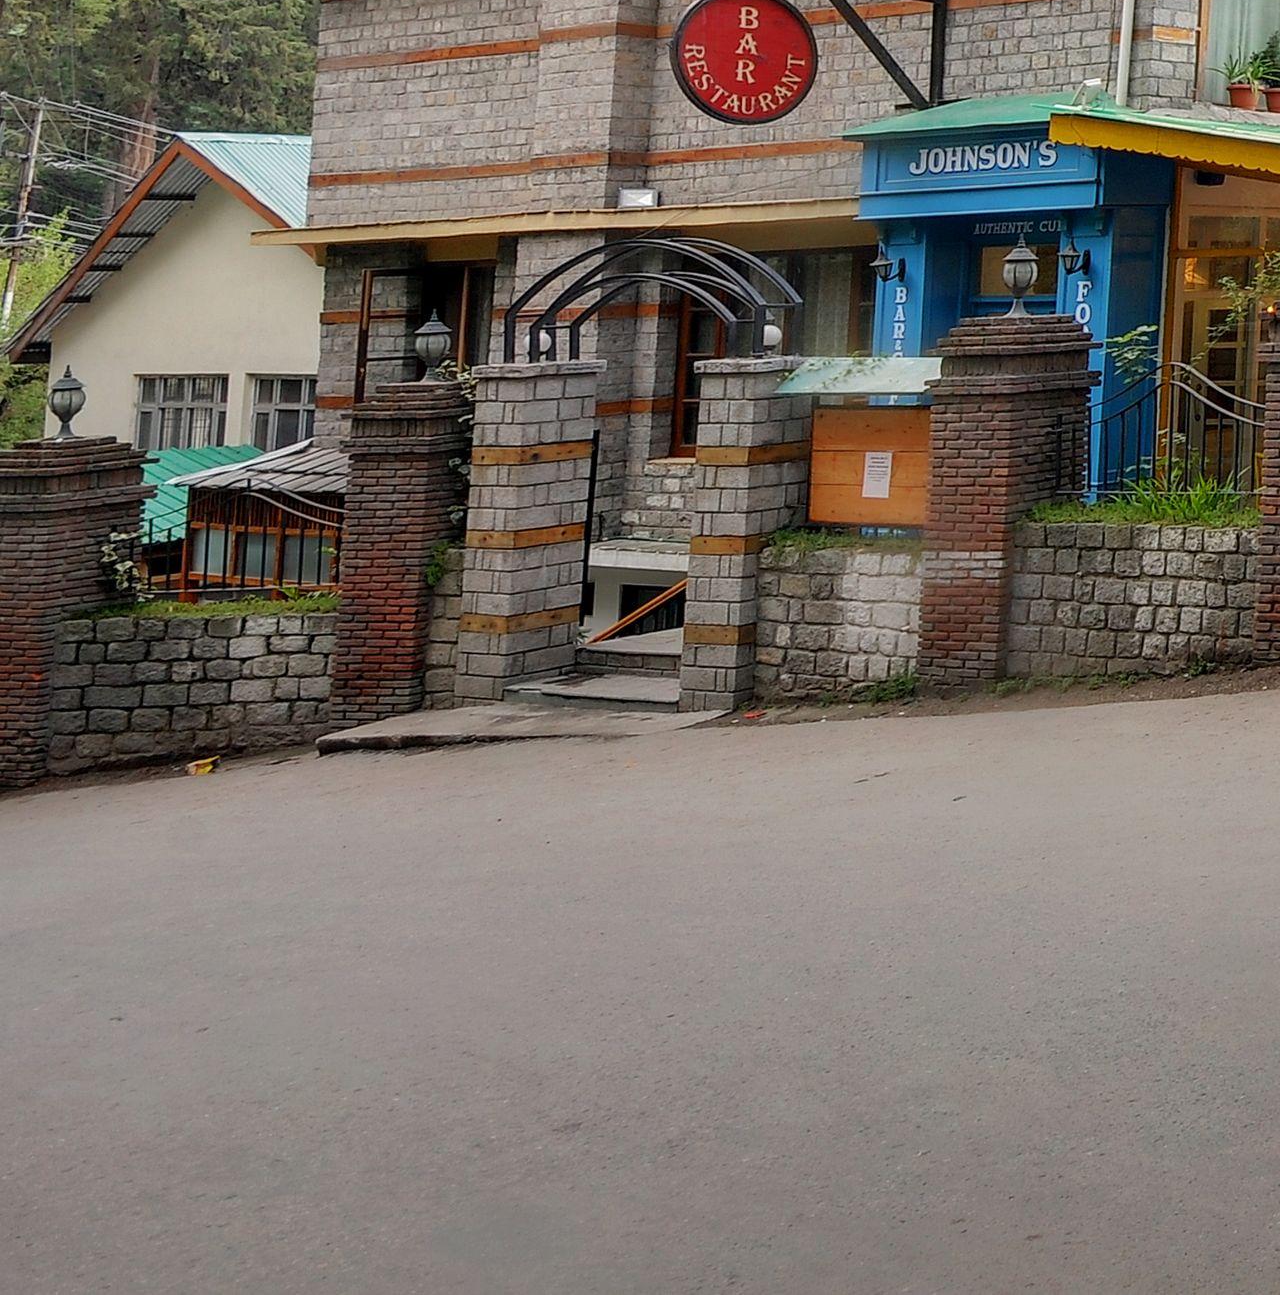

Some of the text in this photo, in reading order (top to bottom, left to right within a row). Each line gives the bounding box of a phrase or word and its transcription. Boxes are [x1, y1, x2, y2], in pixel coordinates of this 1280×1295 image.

[735, 6, 760, 84] BAR
[684, 43, 806, 115] RESTAURANT
[909, 140, 1057, 176] JOHNSON'S
[973, 220, 1034, 235] AUTHENTIC
[893, 287, 907, 339] BAR
